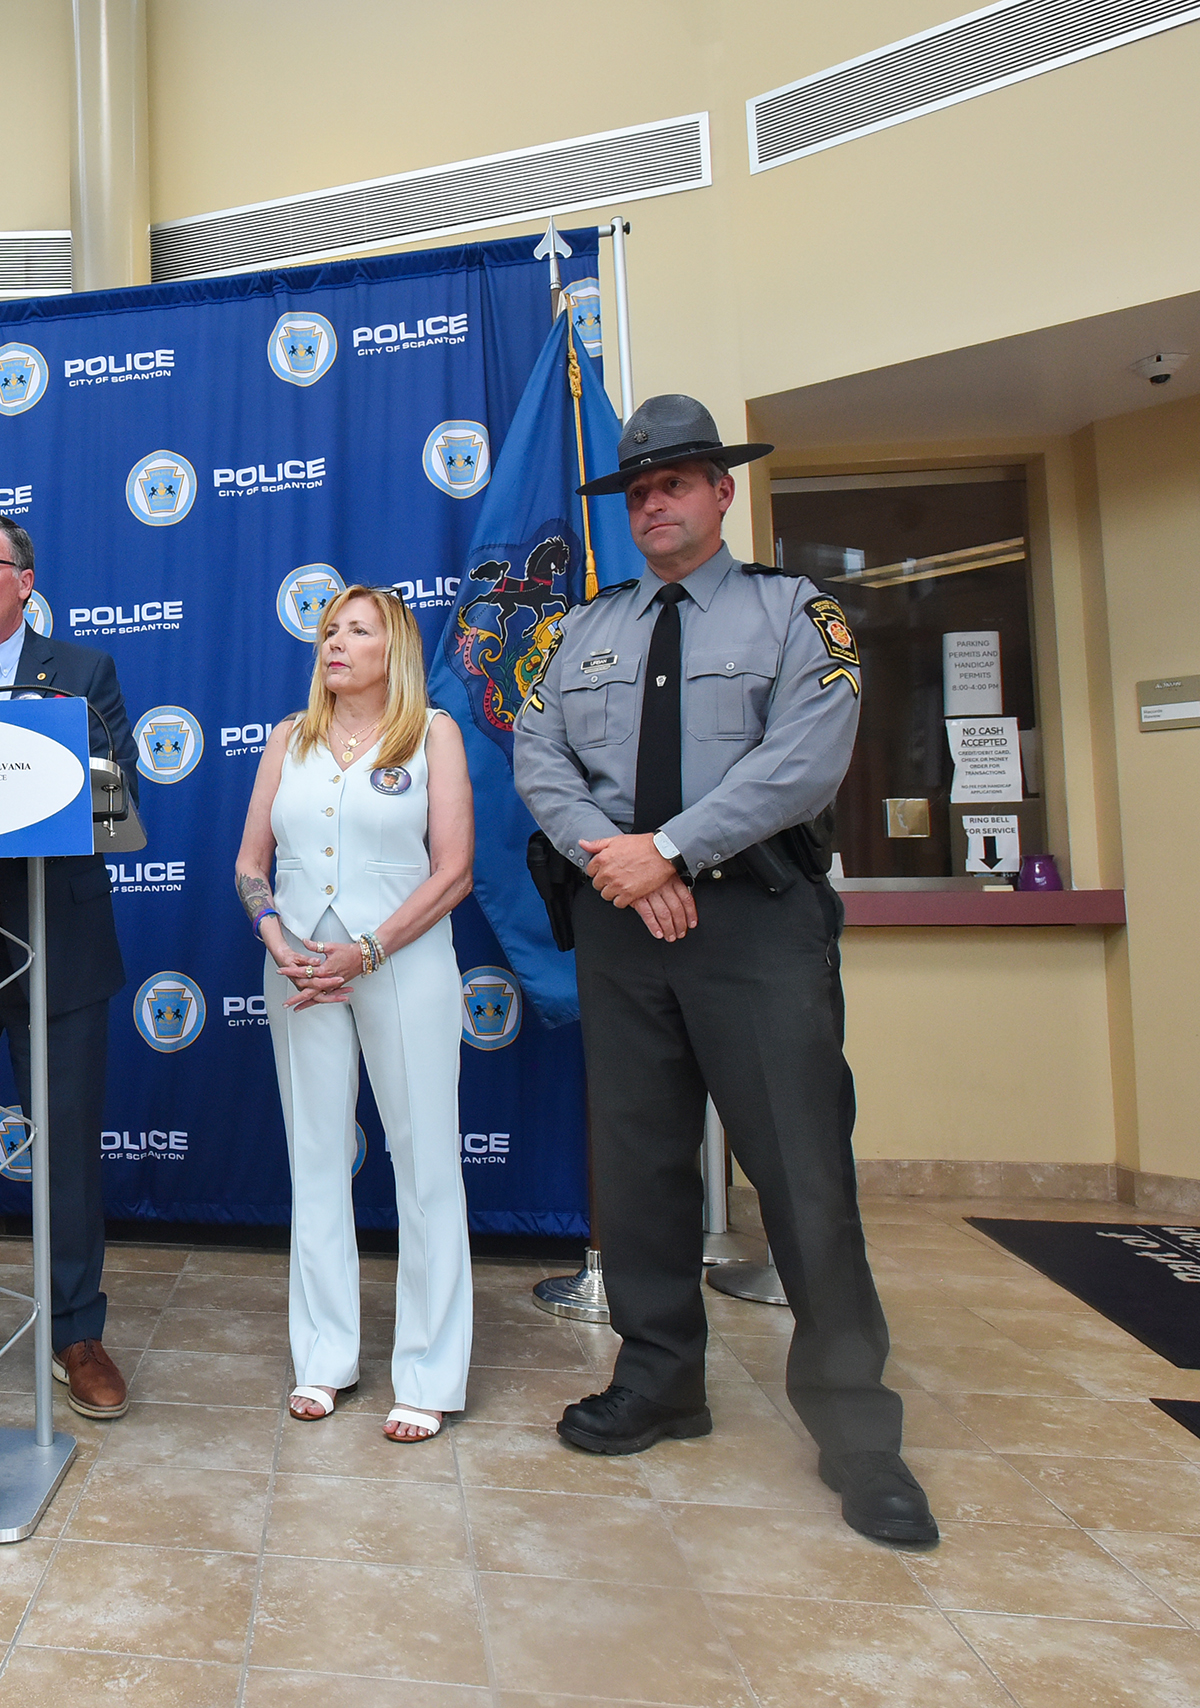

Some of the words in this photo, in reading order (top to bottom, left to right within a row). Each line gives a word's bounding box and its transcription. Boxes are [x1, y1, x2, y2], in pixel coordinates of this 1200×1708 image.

[352, 313, 469, 348] POLICE
[357, 346, 383, 356] CITY
[385, 344, 401, 353] OF
[402, 335, 465, 350] SCRANTON
[64, 349, 175, 378] POLICE
[68, 378, 94, 387] CITY
[95, 375, 109, 384] OF
[110, 369, 172, 383] SCRANTON
[212, 456, 327, 488] POLICE
[217, 489, 245, 498] CITY
[246, 486, 260, 496] OF
[261, 480, 324, 494] SCRANTON
[391, 576, 462, 601] OLIC
[69, 600, 184, 628] POLICE
[73, 628, 100, 637] CITY
[101, 627, 117, 635] OF
[118, 622, 180, 635] SCRANTON
[464, 633, 475, 672] VIRTUE
[948, 651, 981, 659] PERMITS
[982, 650, 998, 658] AND
[483, 686, 500, 726] LIBERTY
[962, 727, 976, 735] NO
[978, 726, 1004, 735] CASH
[225, 747, 249, 757] CITY
[961, 738, 1008, 747] ACCEPTED
[105, 861, 186, 883] OLICE
[121, 884, 182, 893] SCRANTON
[228, 1018, 255, 1027] CITY
[101, 1130, 188, 1150] OLICE
[108, 1152, 124, 1160] OF
